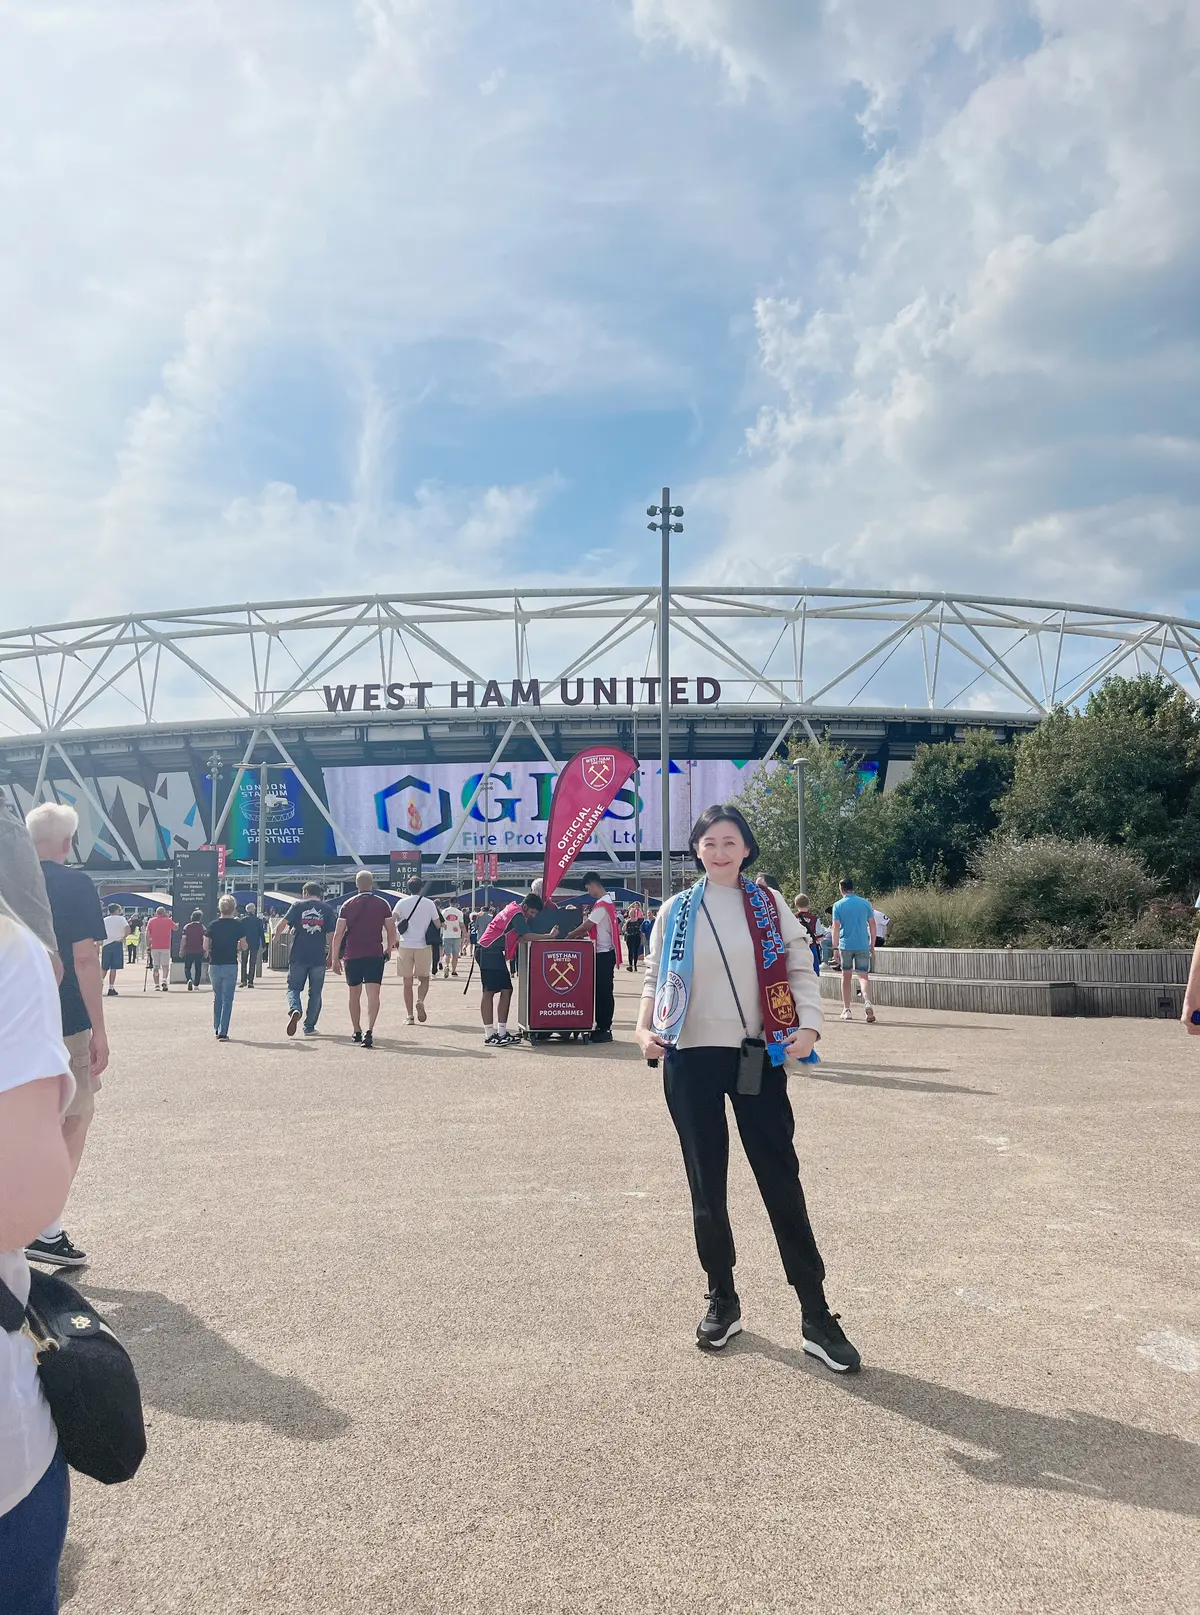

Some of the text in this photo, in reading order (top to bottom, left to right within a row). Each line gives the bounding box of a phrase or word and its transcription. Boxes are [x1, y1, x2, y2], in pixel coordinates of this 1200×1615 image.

[323, 676, 721, 712] WEST HAM UNITED
[241, 790, 288, 798] STAIUM
[462, 831, 497, 846] Fire
[613, 829, 643, 844] Ltd
[557, 806, 591, 850] OFFICIAL
[557, 803, 605, 869] PROGRAMME
[177, 859, 182, 868] 1
